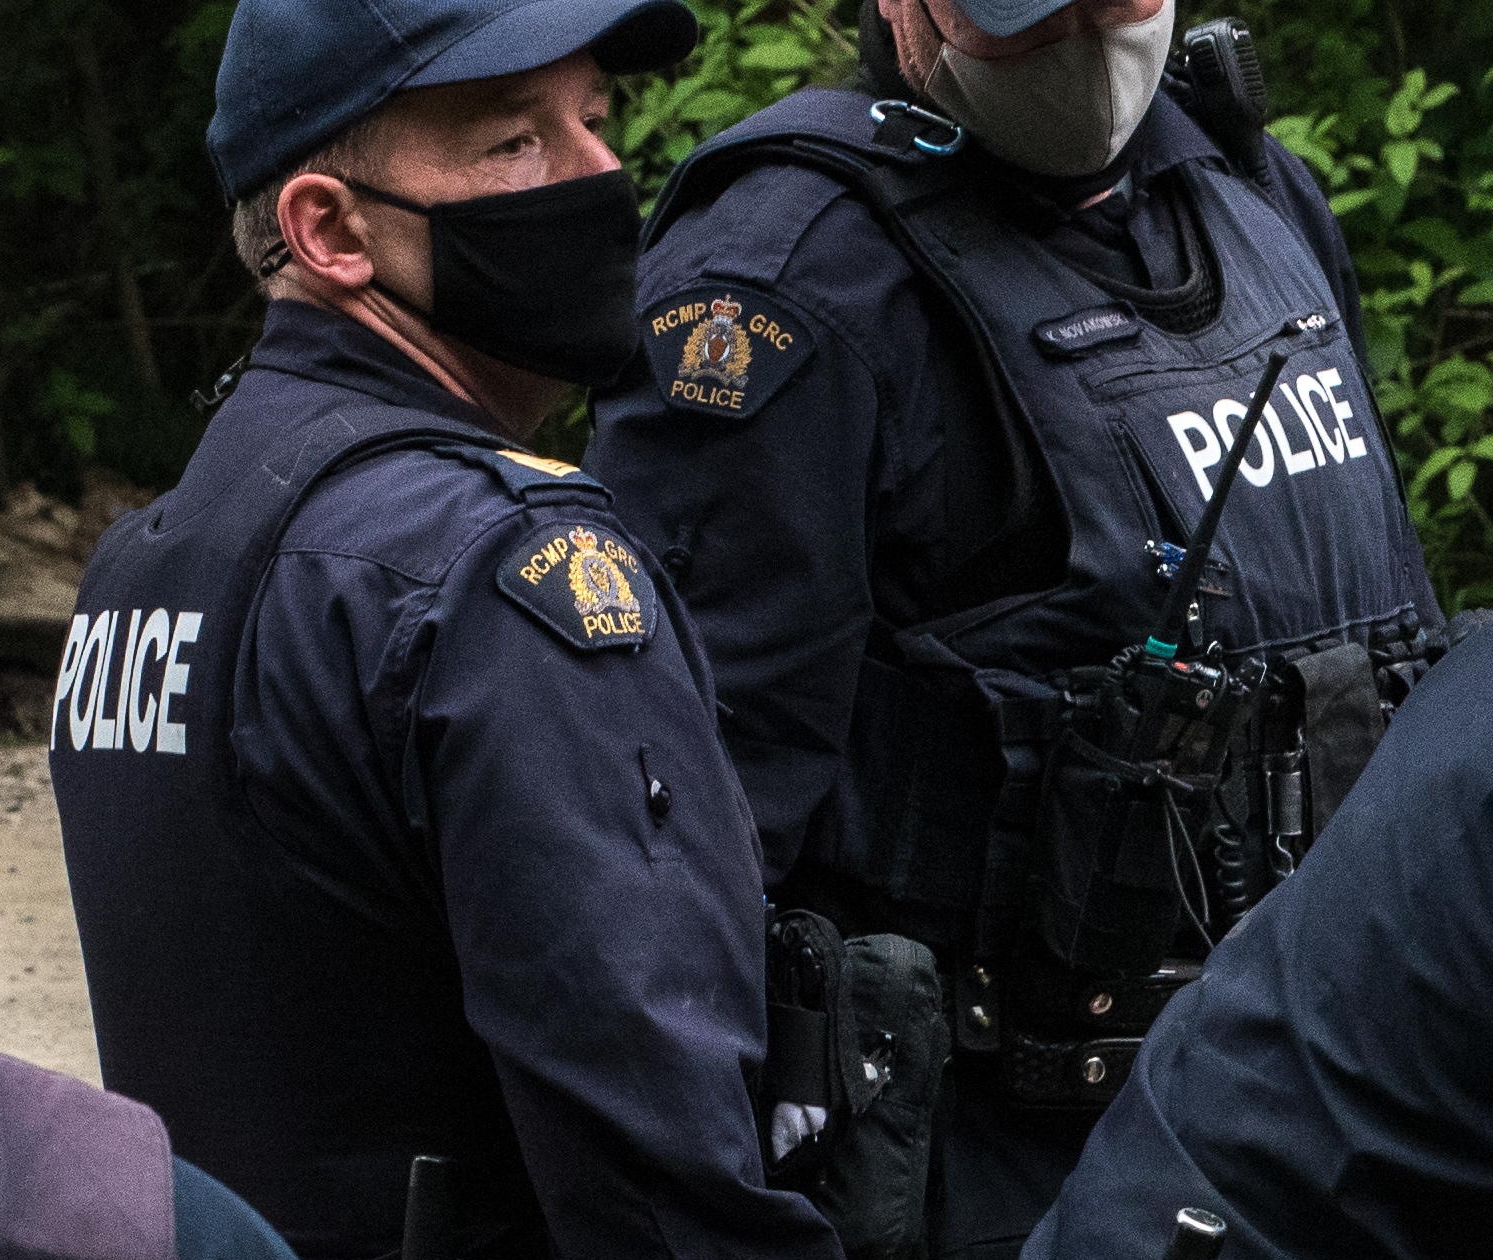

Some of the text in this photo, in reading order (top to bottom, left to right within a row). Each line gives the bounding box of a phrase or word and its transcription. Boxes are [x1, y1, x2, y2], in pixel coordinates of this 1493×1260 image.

[652, 302, 794, 351] RCMP GRC
[670, 380, 746, 410] POLICE
[1166, 366, 1368, 502] POLICE
[519, 537, 639, 586] RCMP GRC
[582, 612, 646, 639] POLICE
[50, 607, 205, 756] POLICE
